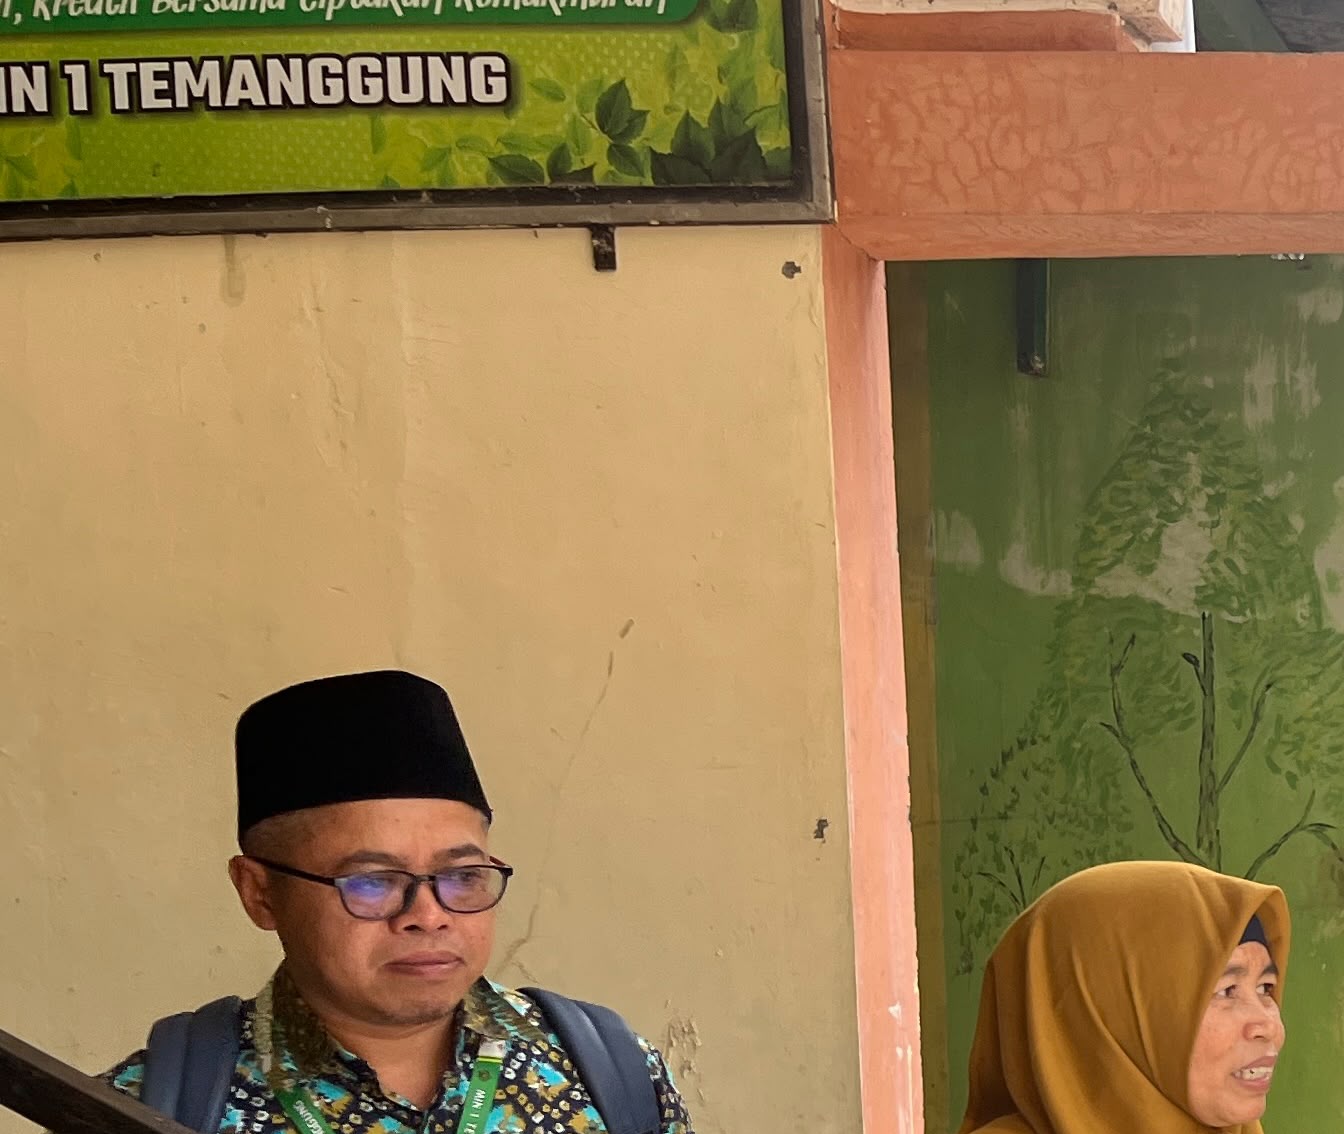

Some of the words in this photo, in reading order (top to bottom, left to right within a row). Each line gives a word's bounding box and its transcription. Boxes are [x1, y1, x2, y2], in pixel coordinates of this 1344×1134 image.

[62, 62, 90, 113] 1
[101, 54, 509, 112] TEMANGGUNG
[472, 1088, 486, 1109] MIN
